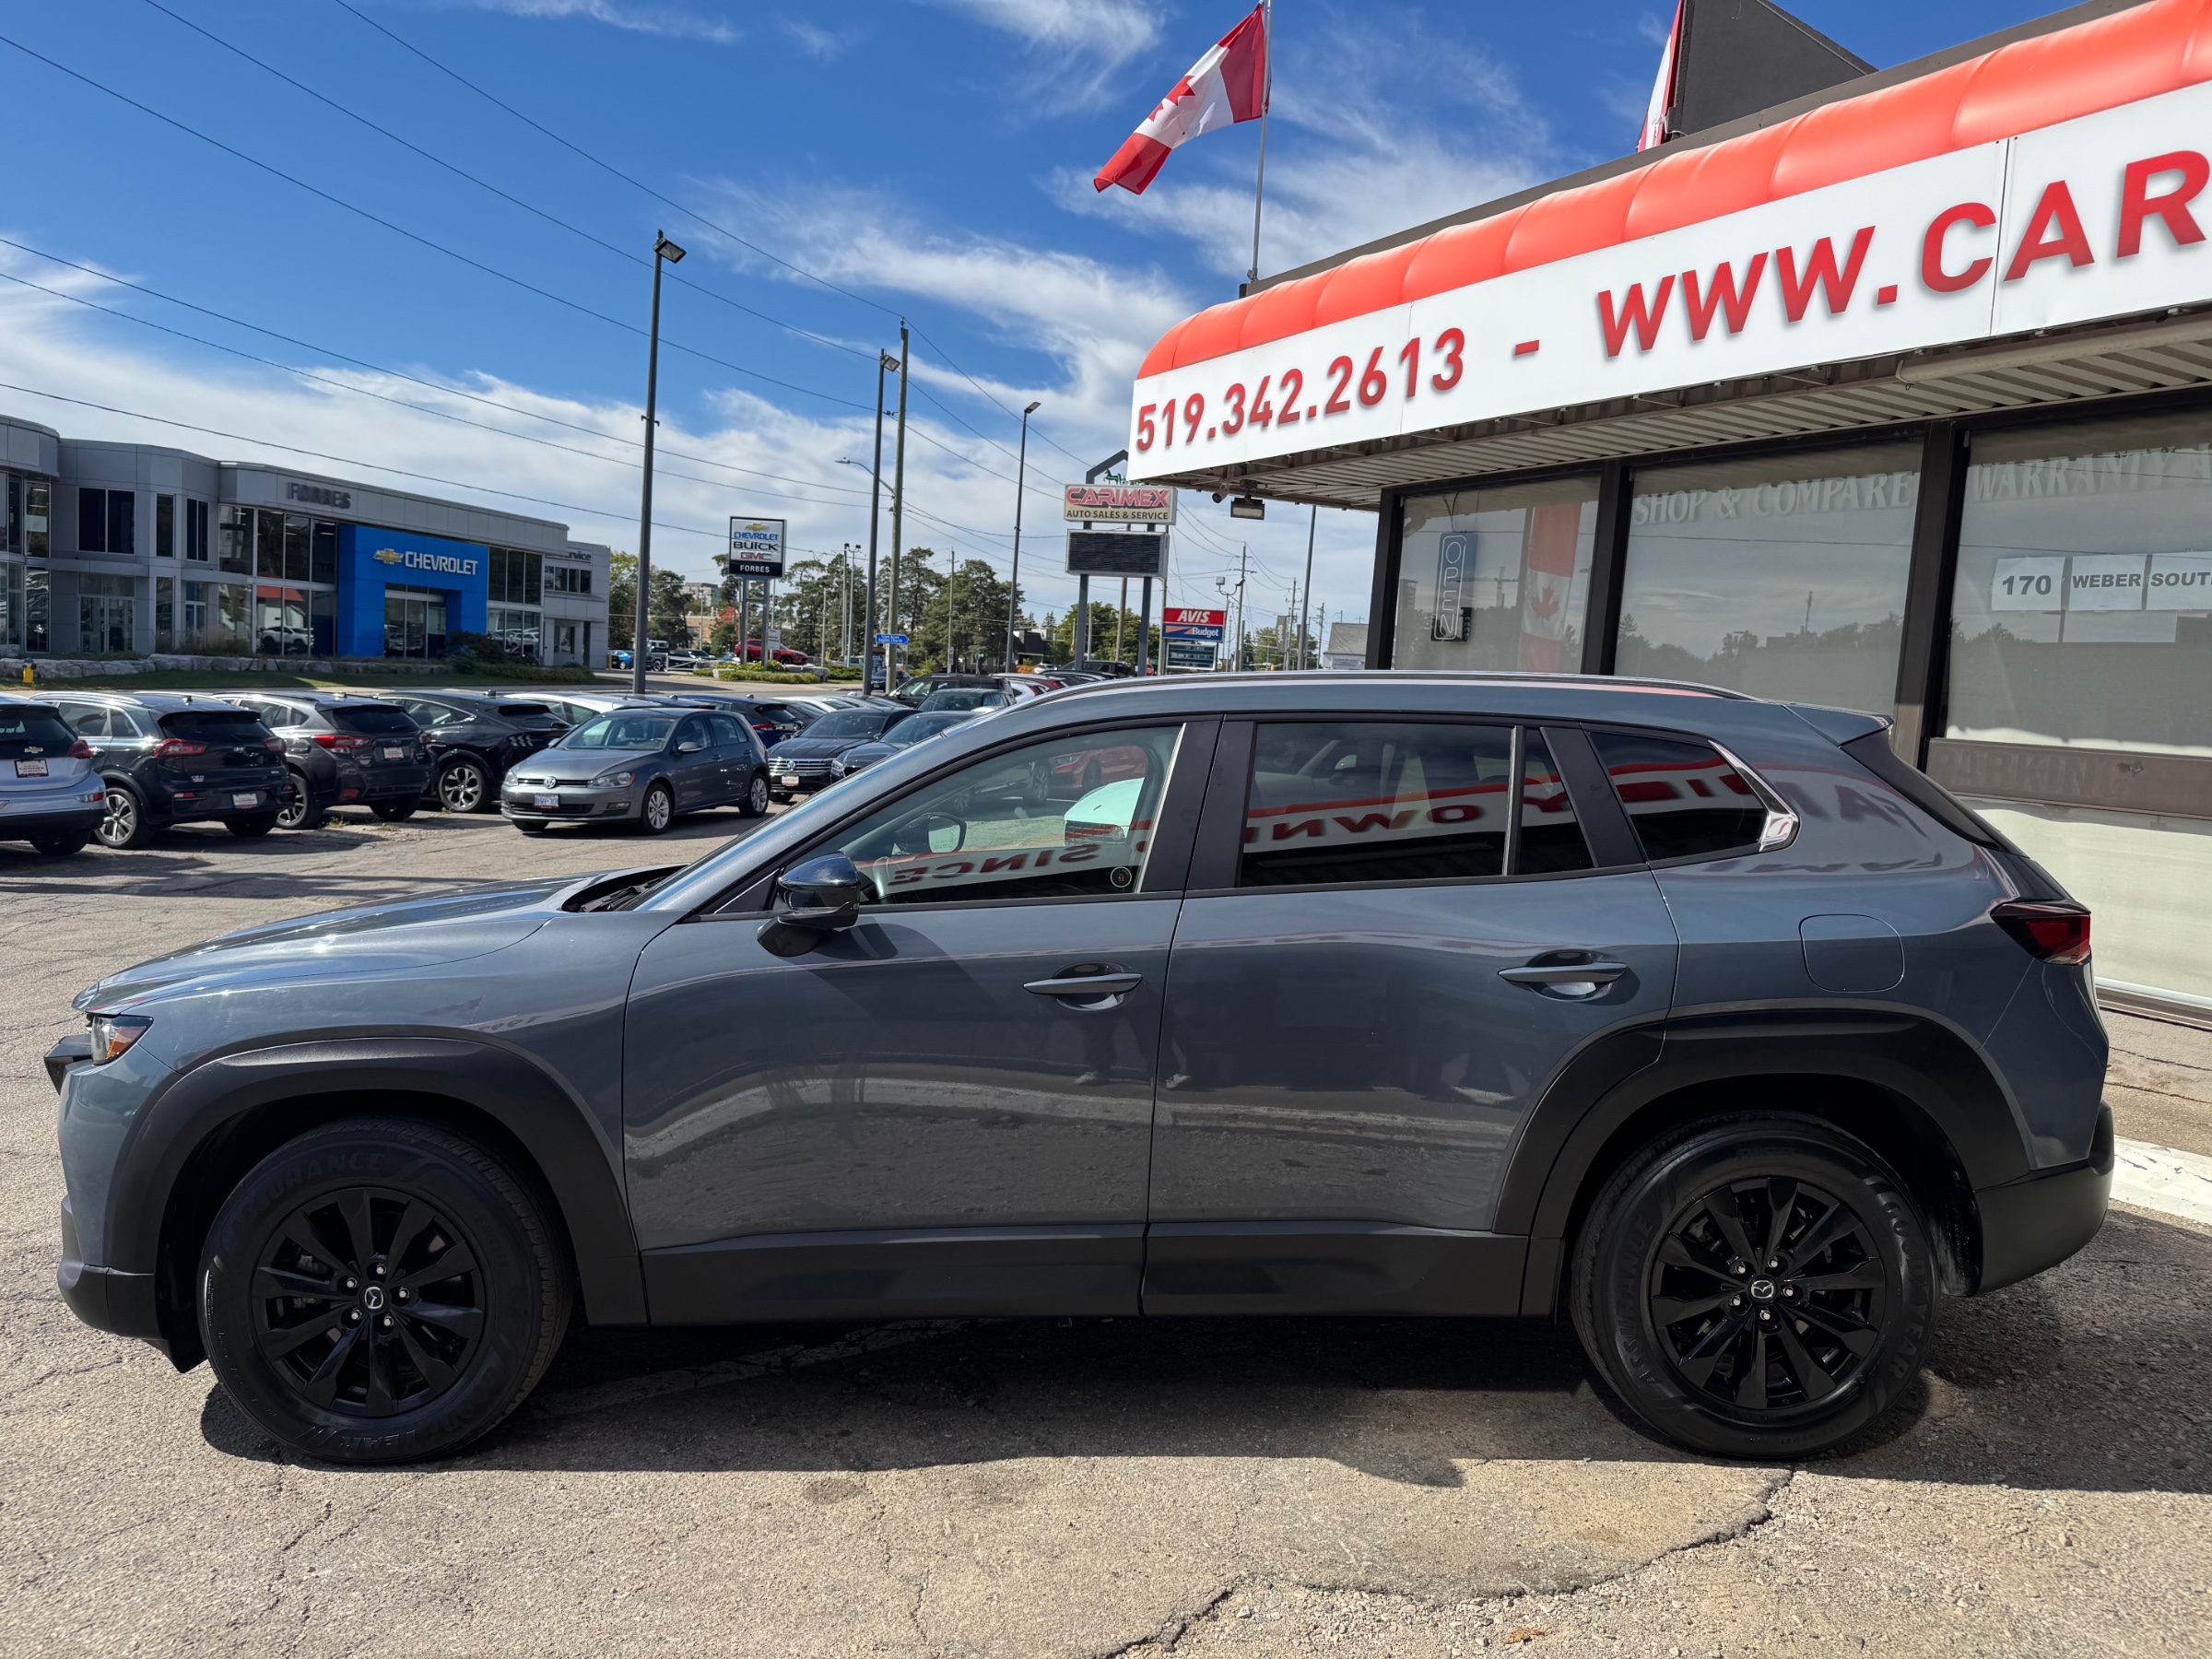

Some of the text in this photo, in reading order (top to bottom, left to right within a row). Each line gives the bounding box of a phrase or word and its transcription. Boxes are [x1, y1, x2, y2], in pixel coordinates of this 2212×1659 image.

[1136, 326, 1465, 453] 519.342.2613
[1597, 149, 2210, 358] WWW.CAR
[1972, 446, 2176, 501] WARRANTY
[1066, 488, 1171, 507] CARIMEX
[1633, 472, 1914, 525] SHOP & COMPARE
[1066, 510, 1091, 518] AUTO
[1092, 511, 1121, 519] SALES
[1131, 512, 1169, 520] SERVICE
[734, 531, 779, 541] CHEVROLET
[733, 541, 779, 551] BUICK
[405, 550, 478, 576] CHEVROLET
[740, 551, 772, 560] GMC
[739, 564, 771, 573] FORBES
[1439, 541, 1462, 637] OPEN
[2001, 571, 2212, 596] 170 WEBER SOUT
[1177, 609, 1211, 624] AVIS
[1192, 627, 1219, 638] Budget
